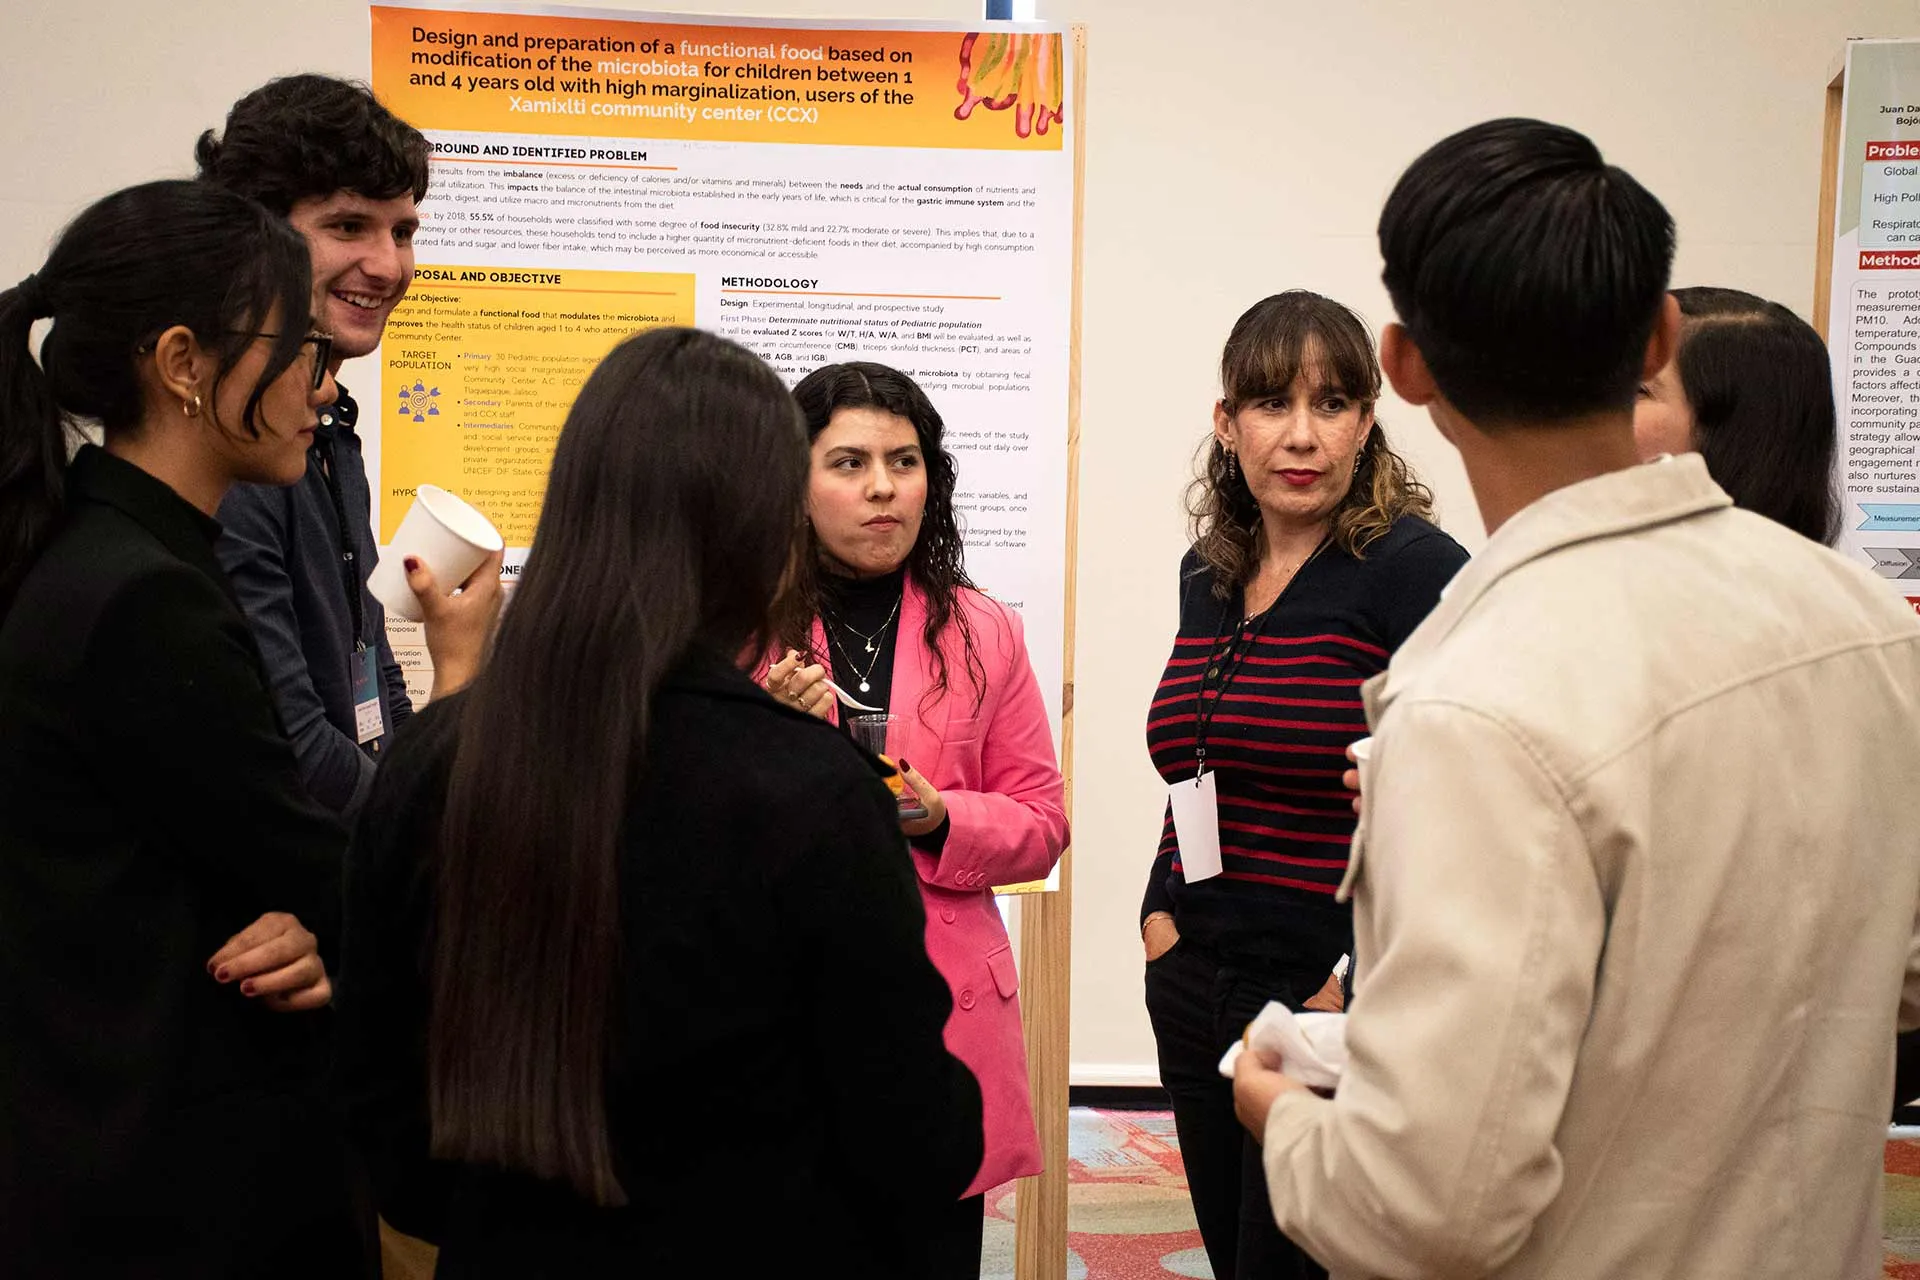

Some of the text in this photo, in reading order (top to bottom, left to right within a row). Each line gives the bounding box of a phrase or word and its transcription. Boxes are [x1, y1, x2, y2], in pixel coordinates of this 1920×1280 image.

[412, 28, 912, 63] Design and preparation of a functional food based on
[411, 48, 913, 84] modification of the microbiota for children between 1
[409, 70, 914, 105] and 4 years old with high marginalization, users of the
[508, 96, 818, 124] Xamixlti community center (CCX)
[1879, 105, 1920, 114] Juan Da
[1896, 116, 1920, 126] Bojó
[483, 145, 509, 156] AND
[512, 146, 587, 159] IDENTIFIED
[589, 149, 648, 161] PROBLEM
[1868, 144, 1920, 157] Proble
[1883, 166, 1918, 176] Global
[438, 166, 463, 176] results
[466, 167, 485, 177] from
[488, 168, 500, 178] the
[503, 168, 543, 179] imbalance
[546, 170, 575, 182] (excess
[578, 173, 586, 181] or
[589, 171, 628, 184] deficiency
[631, 173, 640, 183] of
[641, 173, 671, 184] calories
[673, 175, 698, 185] and/or
[702, 176, 732, 186] vitamins
[735, 177, 750, 187] and
[752, 178, 787, 190] minerals)
[789, 179, 822, 189] between
[825, 180, 837, 189] the
[840, 180, 863, 190] needs
[866, 181, 880, 191] and
[883, 181, 895, 191] the
[897, 182, 921, 192] actual
[923, 182, 973, 195] consumption
[976, 184, 984, 193] of
[986, 184, 1019, 194] nutrients
[1021, 185, 1036, 195] and
[507, 182, 539, 194] impacts
[916, 196, 1035, 209] gastric immune system and the
[1874, 193, 1920, 205] High Poll
[469, 212, 553, 223] 55.5% of households
[700, 221, 760, 233] food insecurity
[1872, 219, 1920, 232] Respirato
[1887, 233, 1920, 242] can ca
[1861, 254, 1920, 266] Method
[414, 269, 561, 284] POSAL AND OBJECTIVE
[721, 277, 819, 289] METHODOLOGY
[420, 294, 461, 304] Objective:
[1857, 289, 1920, 300] The protot
[856, 302, 872, 311] and
[874, 302, 920, 314] prospective
[922, 303, 944, 315] study
[480, 309, 659, 322] functional food that modulates the microbiota
[1855, 315, 1889, 325] PM10.
[387, 319, 424, 329] improves
[768, 315, 982, 331] Determinate nutritional status of Pediatric population
[387, 332, 433, 343] Community
[753, 328, 790, 337] evaluated
[791, 328, 797, 337] Z
[916, 331, 932, 340] BMI
[1854, 341, 1917, 352] Compounds
[401, 350, 437, 360] TARGET
[1853, 354, 1863, 364] in
[1870, 354, 1887, 364] the
[389, 360, 452, 370] POPULATION
[919, 369, 959, 377] microbiota
[1853, 368, 1897, 378] provides
[1903, 369, 1910, 377] a
[1852, 380, 1920, 390] factors affecti
[1851, 393, 1920, 403] Moreover, th
[1851, 406, 1918, 417] incorporating
[1850, 420, 1920, 430] community pa
[959, 430, 981, 439] needs
[984, 430, 992, 439] of
[994, 431, 1007, 439] the
[1009, 431, 1029, 441] study
[1849, 432, 1920, 443] strategy allow
[1848, 446, 1915, 456] geographical
[1848, 459, 1913, 469] engagement
[1847, 471, 1917, 480] also nurtures
[1847, 484, 1920, 493] more sustaina
[994, 539, 1026, 548] software
